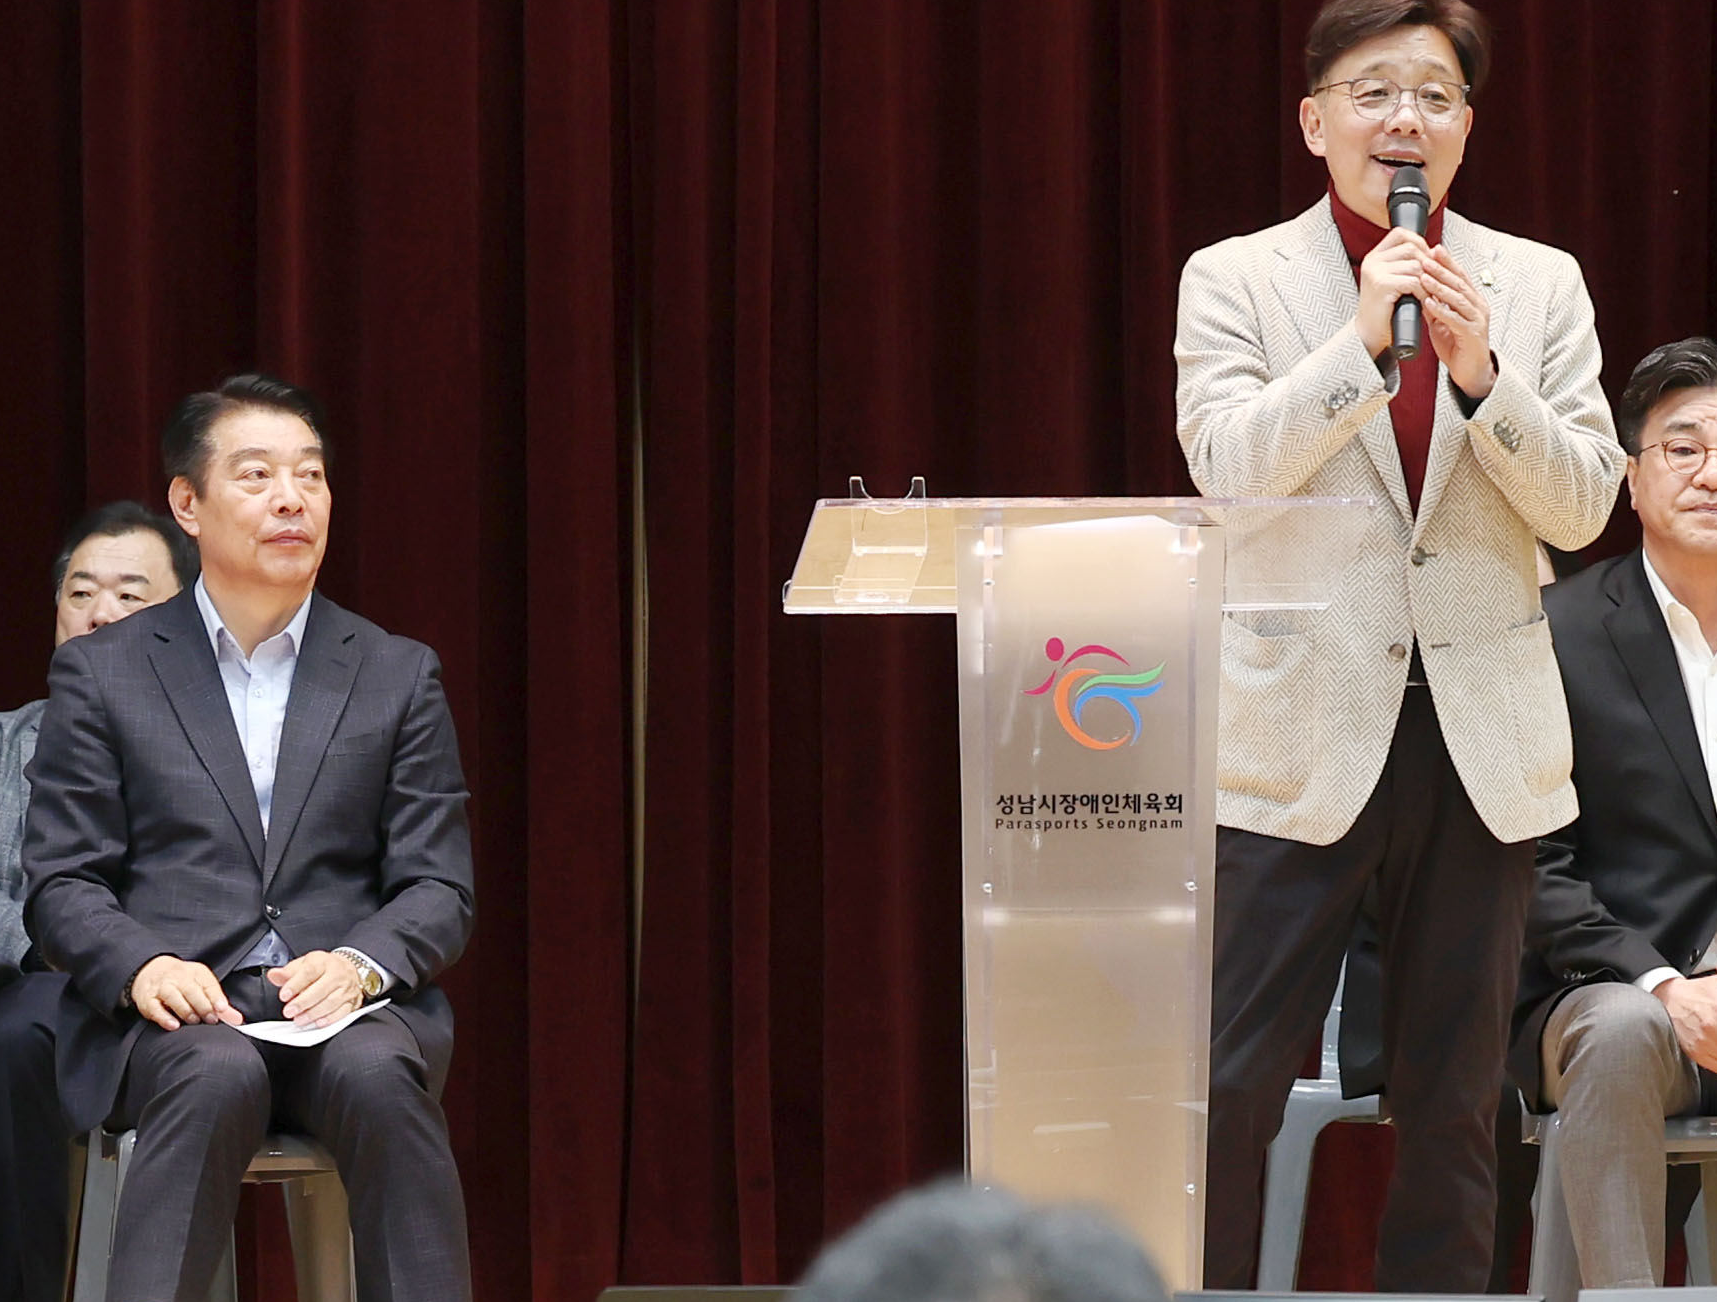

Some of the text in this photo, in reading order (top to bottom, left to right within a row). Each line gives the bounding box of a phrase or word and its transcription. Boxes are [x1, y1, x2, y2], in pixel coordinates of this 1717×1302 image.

[995, 793, 1183, 815] 성남시장애인체육회
[995, 818, 1183, 831] Parasports Seongnam
